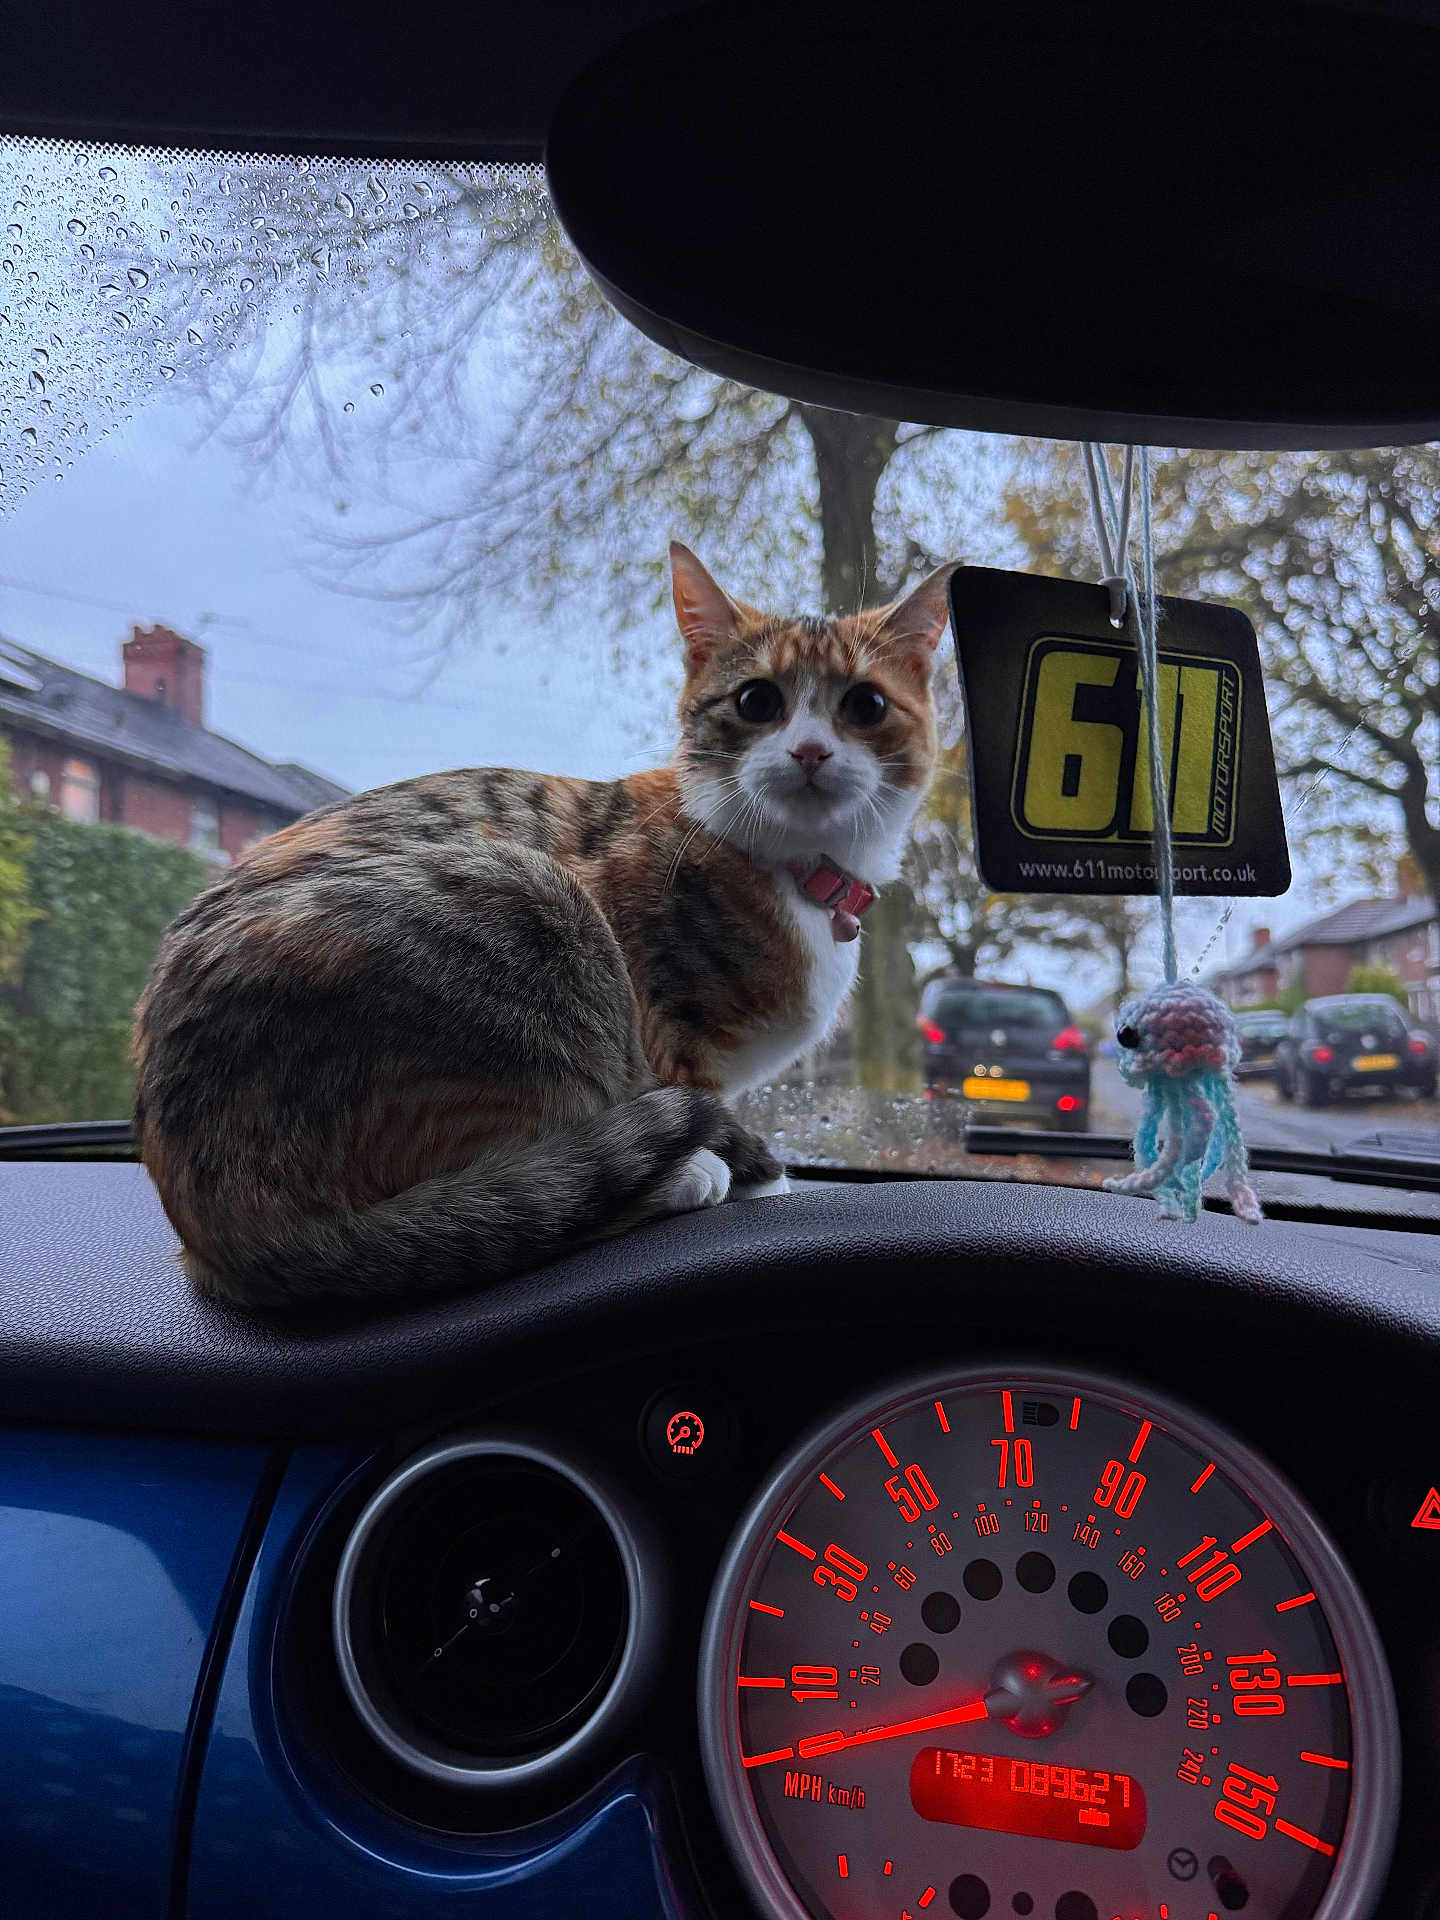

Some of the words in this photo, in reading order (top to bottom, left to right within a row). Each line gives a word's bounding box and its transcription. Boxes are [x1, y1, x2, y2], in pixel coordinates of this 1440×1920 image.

[1024, 651, 1219, 834] 611
[1211, 669, 1235, 838] MOTORSPORT
[990, 1439, 1033, 1488] 70
[884, 1463, 940, 1523] 50
[1093, 1460, 1147, 1519] 90
[974, 1513, 1000, 1537] 100
[1024, 1511, 1048, 1534] 120
[1072, 1522, 1100, 1549] 140
[930, 1532, 953, 1557] 80
[813, 1543, 868, 1602] 30
[893, 1565, 917, 1591] 60
[1117, 1550, 1146, 1580] 160
[1176, 1535, 1243, 1602] 110
[869, 1611, 892, 1635] 40
[1152, 1593, 1182, 1623] 180
[860, 1665, 881, 1685] 20
[1176, 1643, 1204, 1676] 200
[791, 1665, 839, 1703] 10
[1226, 1650, 1286, 1716] 130
[1187, 1697, 1210, 1730] 220
[1011, 1760, 1130, 1808] 089627
[1177, 1748, 1205, 1785] 240
[784, 1771, 822, 1802] MPH
[828, 1783, 865, 1809] km/h
[1214, 1762, 1280, 1841] 150
